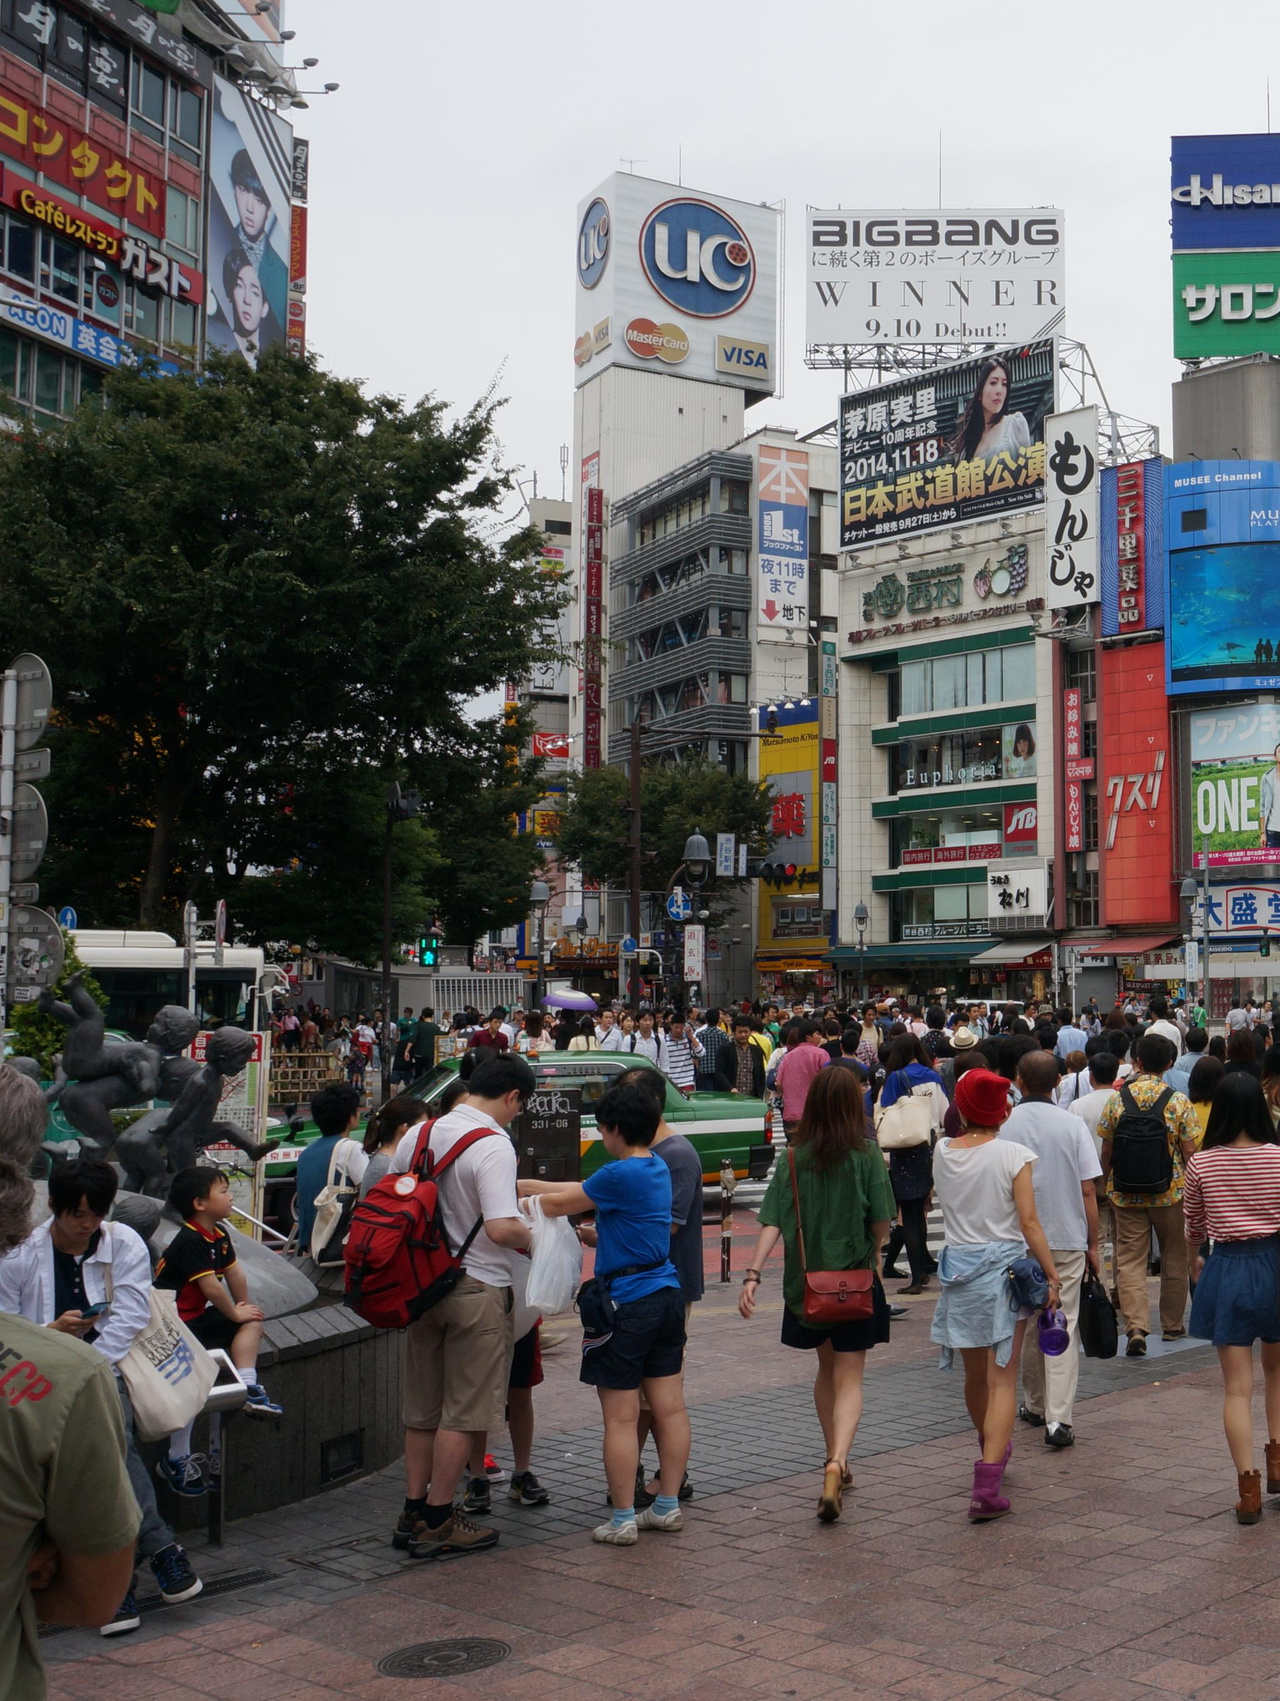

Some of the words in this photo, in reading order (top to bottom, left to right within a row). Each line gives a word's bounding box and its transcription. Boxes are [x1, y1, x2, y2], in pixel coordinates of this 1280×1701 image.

[0, 95, 157, 214] コンタクト
[812, 219, 1059, 247] BIGBANG
[120, 235, 191, 299] ガスト
[812, 249, 1059, 267] に続く第2のボーイズグループ
[815, 279, 1059, 307] WINNER
[595, 324, 609, 344] VISA
[627, 329, 689, 350] MasterCard
[865, 317, 921, 338] 9.10
[935, 321, 1007, 338] Debut!!
[722, 347, 768, 369] VISA
[845, 387, 938, 439] 茅原実里
[844, 439, 939, 484] 2014.11.18
[844, 441, 1047, 526] 日本武道館公演
[1174, 476, 1211, 487] MUSEE
[1215, 471, 1262, 483] Channel
[763, 512, 772, 539] BOOK
[1049, 431, 1095, 598] もんじゃ
[763, 540, 804, 553] ブックファースト
[1118, 468, 1140, 623] 三千里薬品
[761, 558, 805, 579] 夜11時
[770, 579, 797, 596] まで
[907, 576, 963, 613] 西村
[782, 604, 806, 622] 地下
[1067, 693, 1078, 755] お好み焼
[824, 756, 835, 765] JTB
[906, 763, 997, 786] Euphoria
[1105, 750, 1166, 850] クスリ
[1197, 777, 1258, 834] ONE
[773, 792, 806, 838] 薬
[1007, 807, 1037, 835] JTB
[1068, 784, 1080, 848] もんじゃ焼
[904, 852, 931, 862] 国内旅行
[936, 850, 964, 860] 海外旅行
